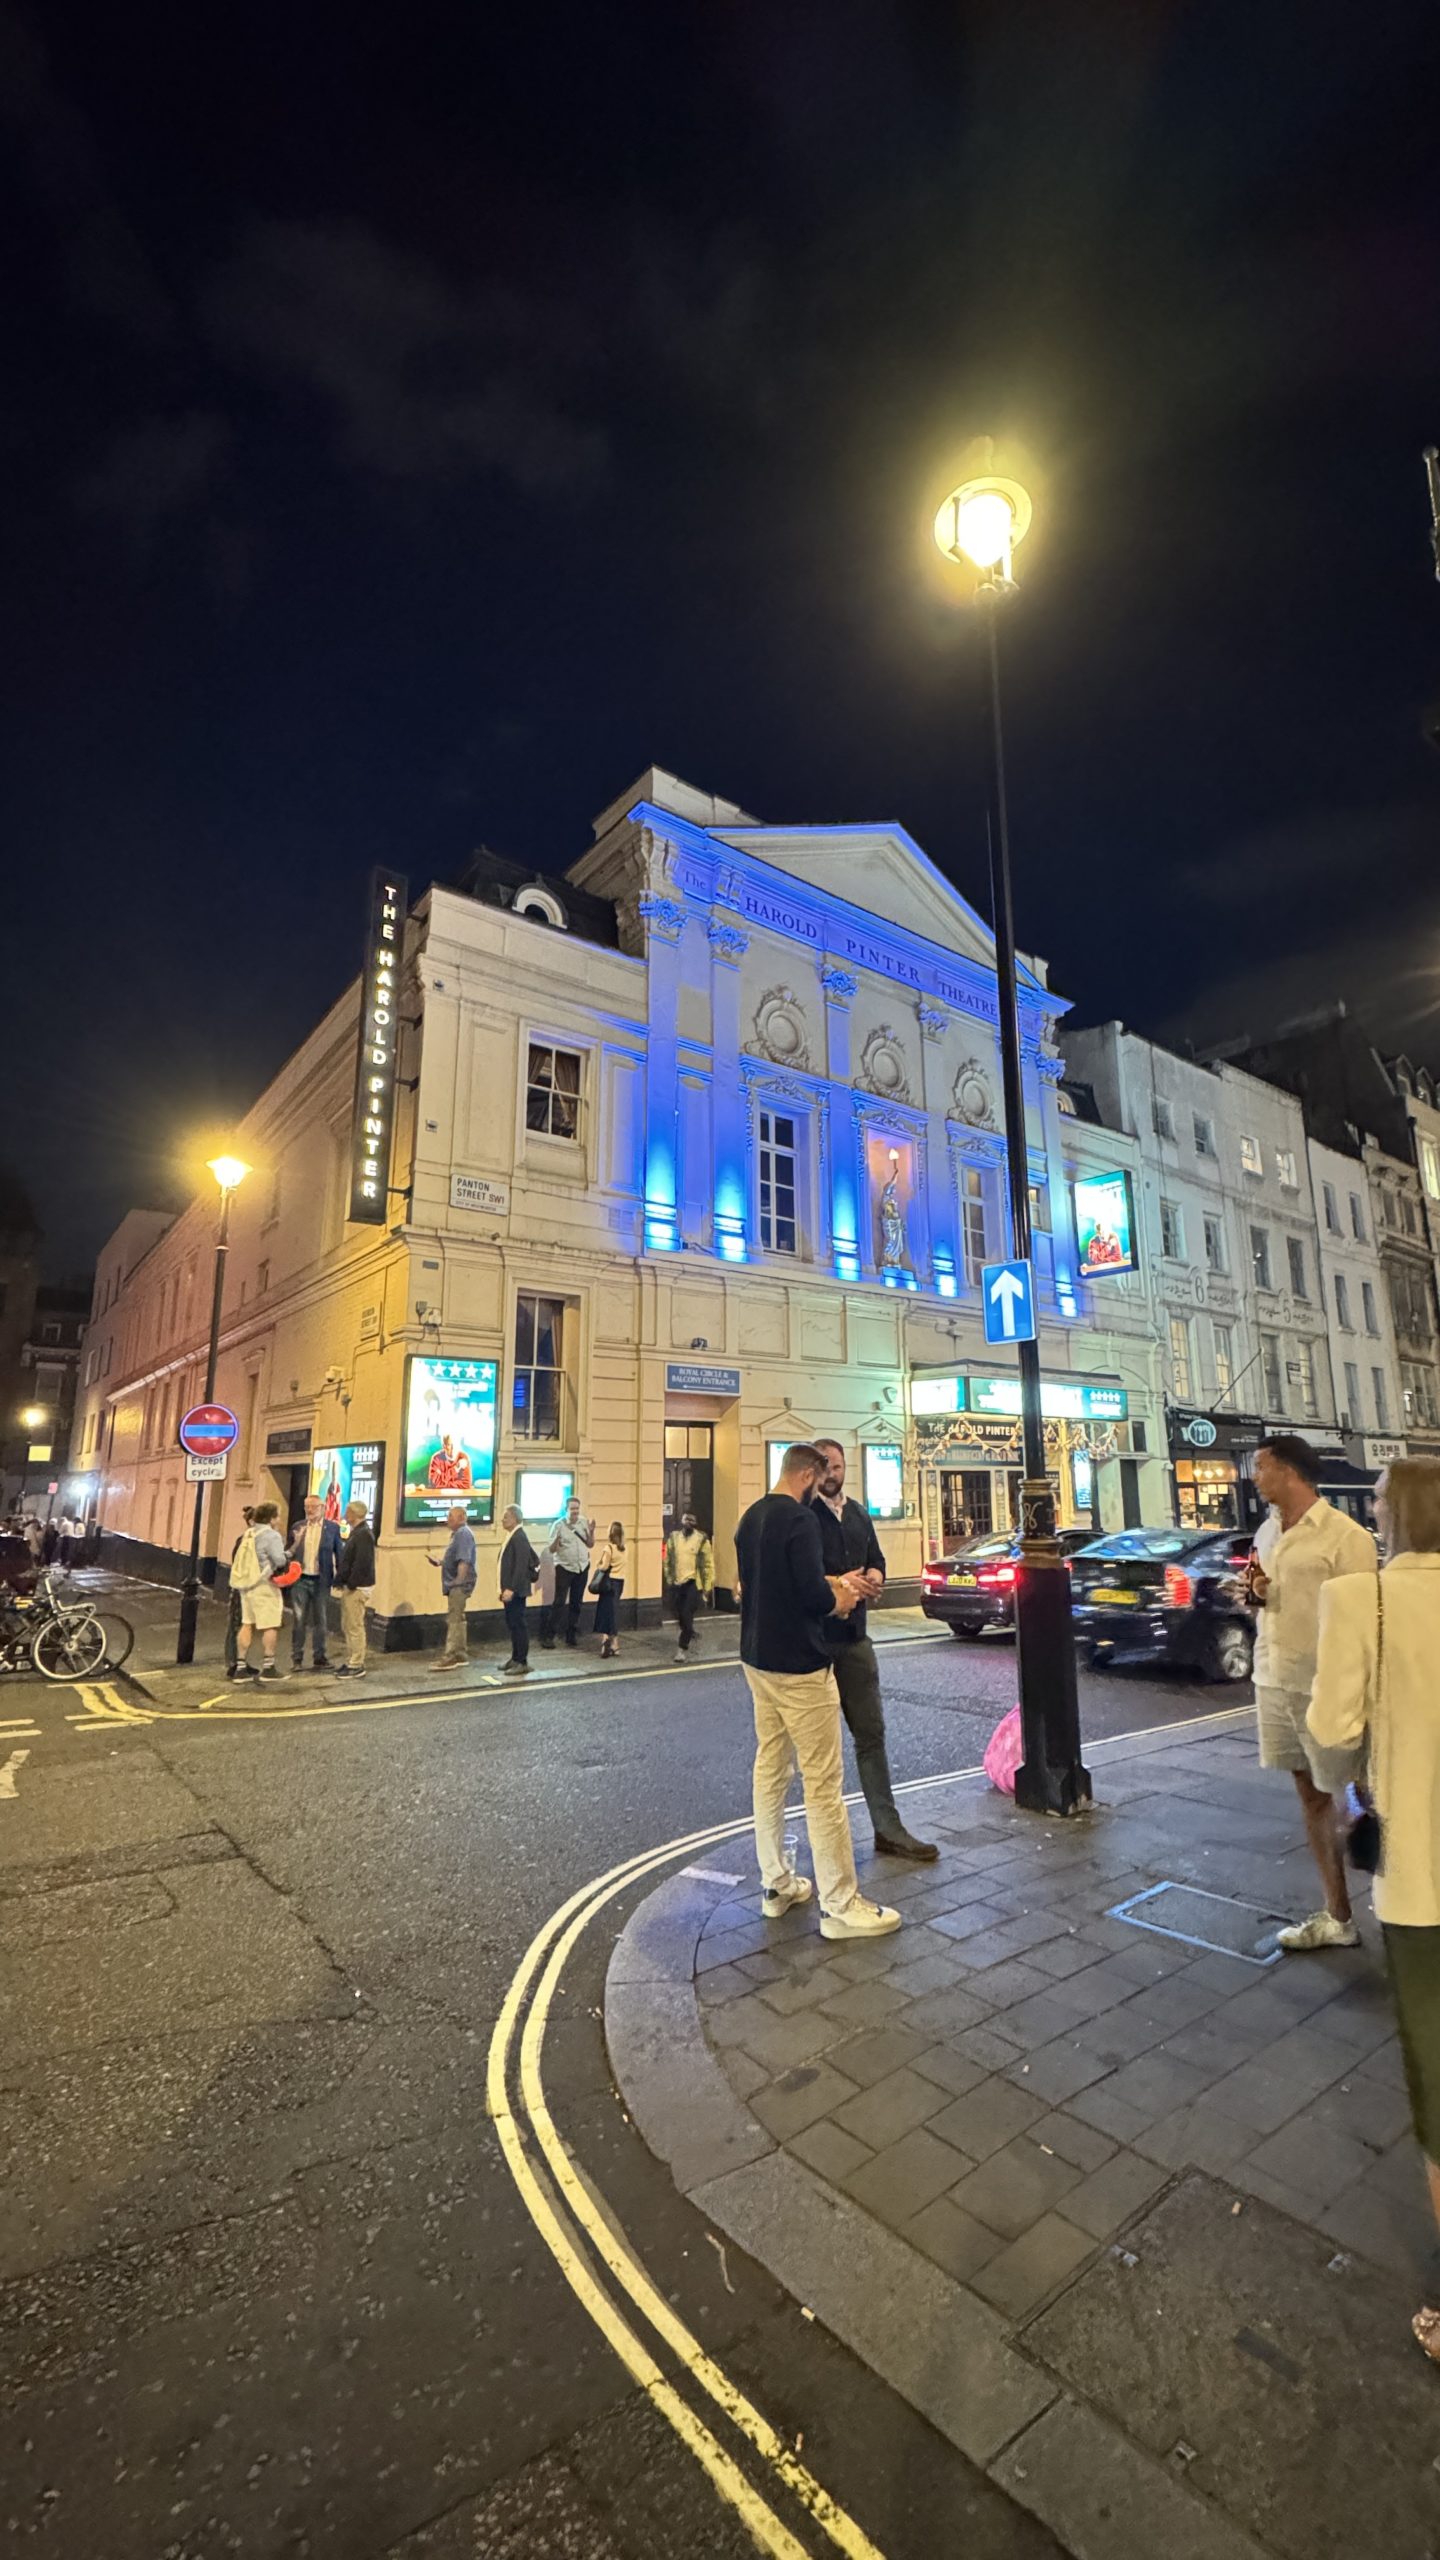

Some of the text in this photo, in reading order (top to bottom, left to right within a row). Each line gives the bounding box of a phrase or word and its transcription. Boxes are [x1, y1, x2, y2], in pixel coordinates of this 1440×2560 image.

[684, 871, 997, 1016] The HAROLD PINTER THEATRE
[363, 886, 397, 1198] THE HAROLD PINTER
[456, 1178, 490, 1191] PANTON
[456, 1187, 505, 1205] STREET SW1
[679, 1368, 700, 1376] ROYAL
[701, 1370, 722, 1378] CIRCLE
[671, 1375, 736, 1386] BALCONY ENTRANCE
[191, 1456, 223, 1466] Except
